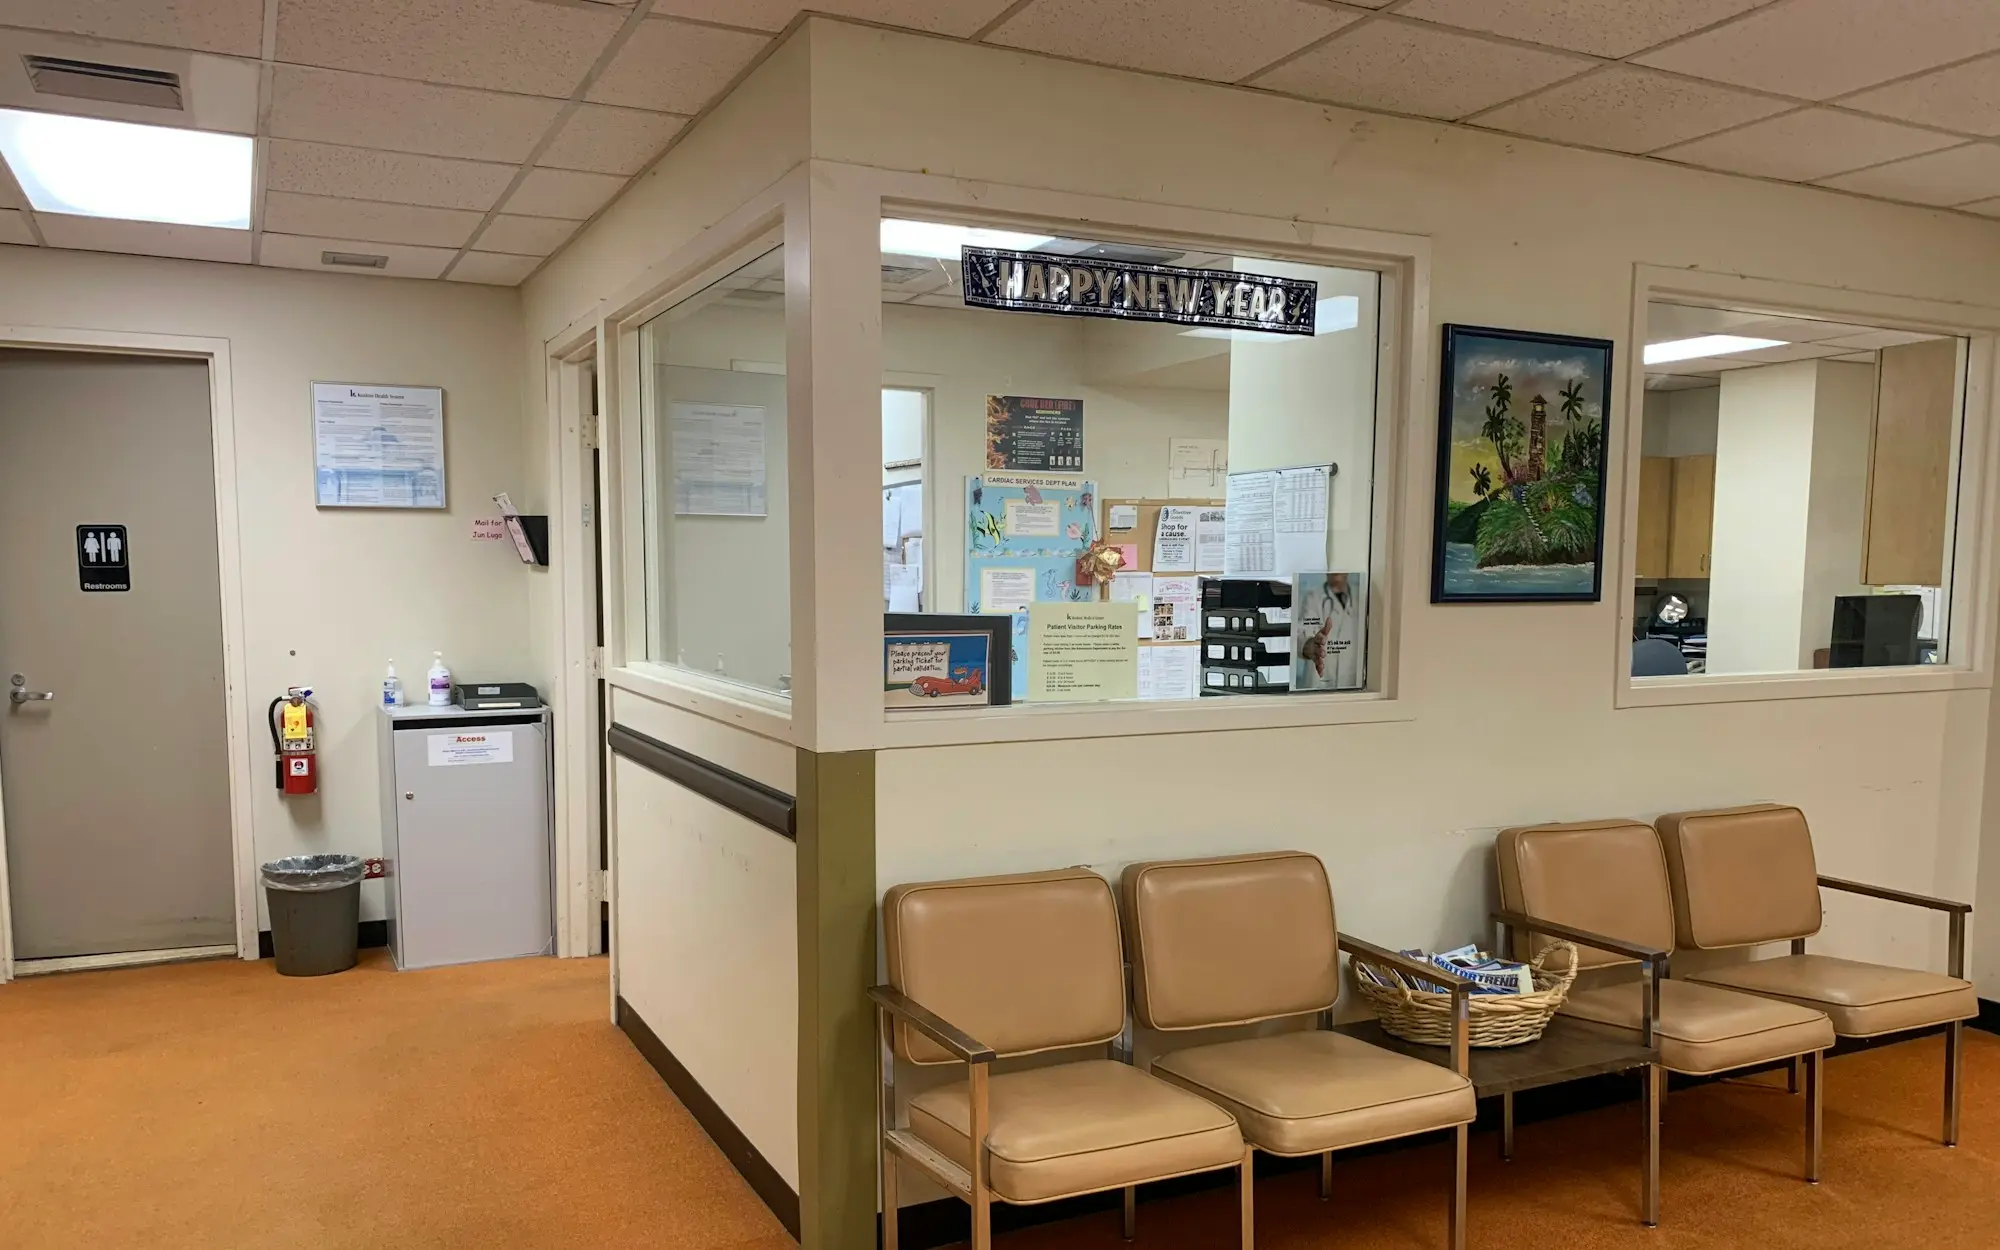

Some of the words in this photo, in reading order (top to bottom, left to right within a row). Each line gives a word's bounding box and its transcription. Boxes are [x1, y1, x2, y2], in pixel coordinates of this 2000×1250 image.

[1000, 260, 1118, 306] HAPPY
[1123, 271, 1204, 315] NEW
[1210, 280, 1287, 323] YEAR
[1015, 478, 1044, 486] SERVICES
[1161, 523, 1176, 531] Shop
[472, 531, 485, 539] Jun
[84, 582, 127, 590] Restrooms
[911, 649, 933, 658] present
[934, 650, 946, 658] your
[893, 658, 914, 667] parking
[893, 664, 913, 675] partial
[456, 735, 486, 743] Access
